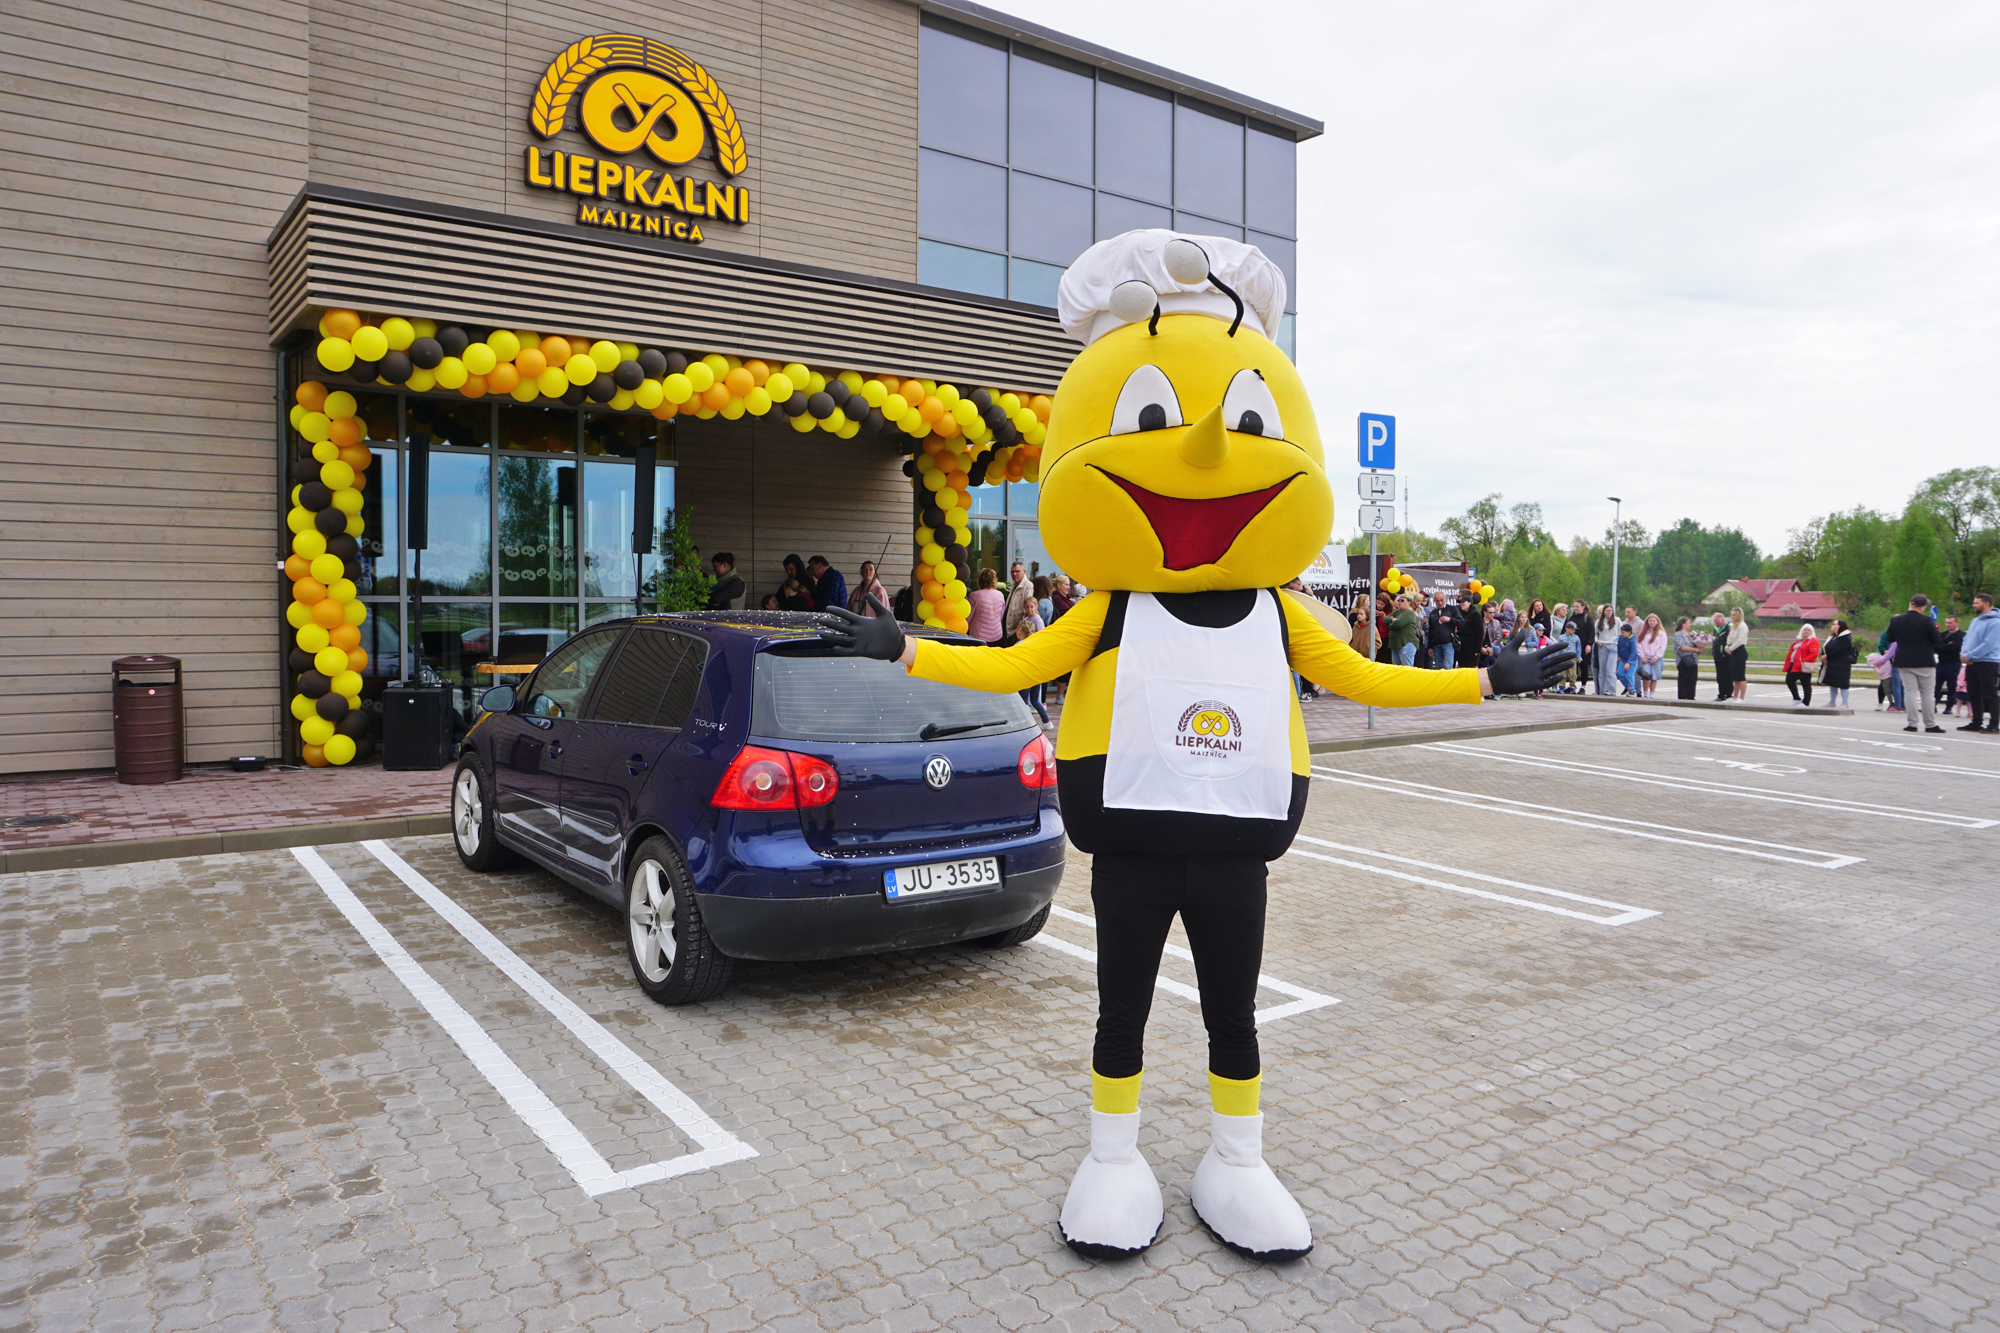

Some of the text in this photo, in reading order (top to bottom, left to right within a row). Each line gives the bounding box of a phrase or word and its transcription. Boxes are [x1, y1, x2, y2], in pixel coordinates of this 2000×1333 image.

[527, 145, 750, 224] LIEPKALNI
[579, 203, 704, 242] MAIZNĪCA
[1367, 419, 1388, 461] P
[1375, 477, 1379, 486] 7
[1434, 578, 1455, 587] VEIKALA
[695, 718, 718, 730] TOUR
[1175, 734, 1242, 752] LIEPKALNI
[1189, 750, 1228, 759] MAIZNĪCA
[887, 885, 897, 894] LV
